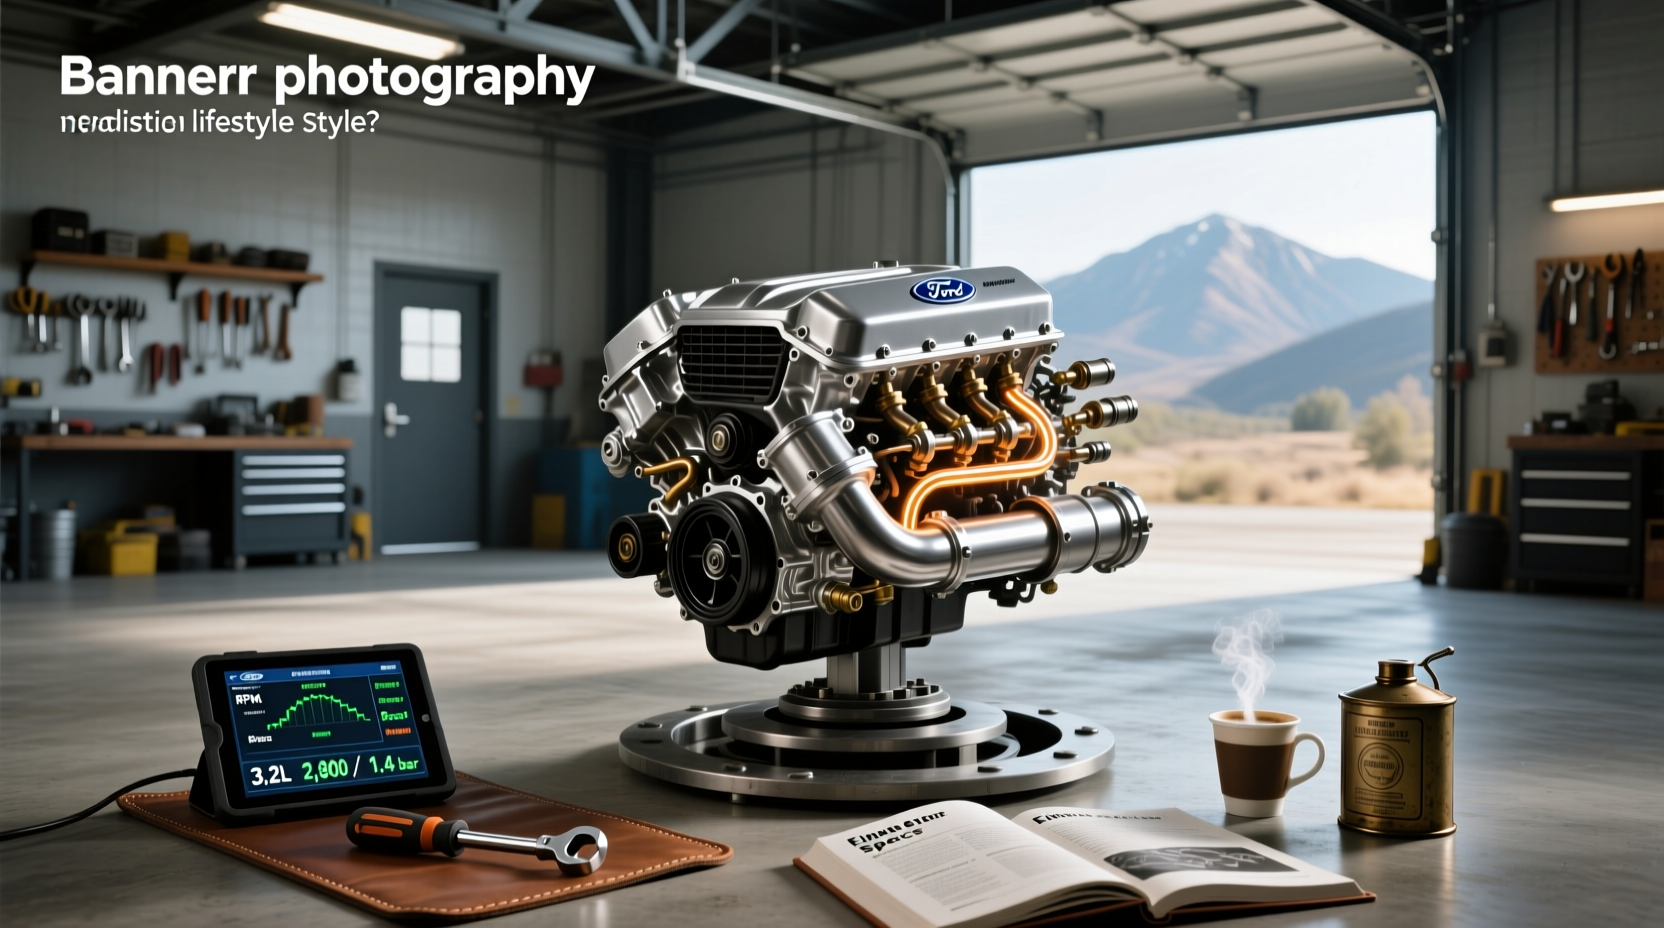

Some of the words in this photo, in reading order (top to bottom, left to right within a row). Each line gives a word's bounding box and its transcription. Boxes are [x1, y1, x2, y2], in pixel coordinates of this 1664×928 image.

[235, 693, 263, 705] RPM
[250, 764, 293, 786] 3.2L
[369, 754, 395, 773] 1.4
[397, 756, 419, 770] bar
